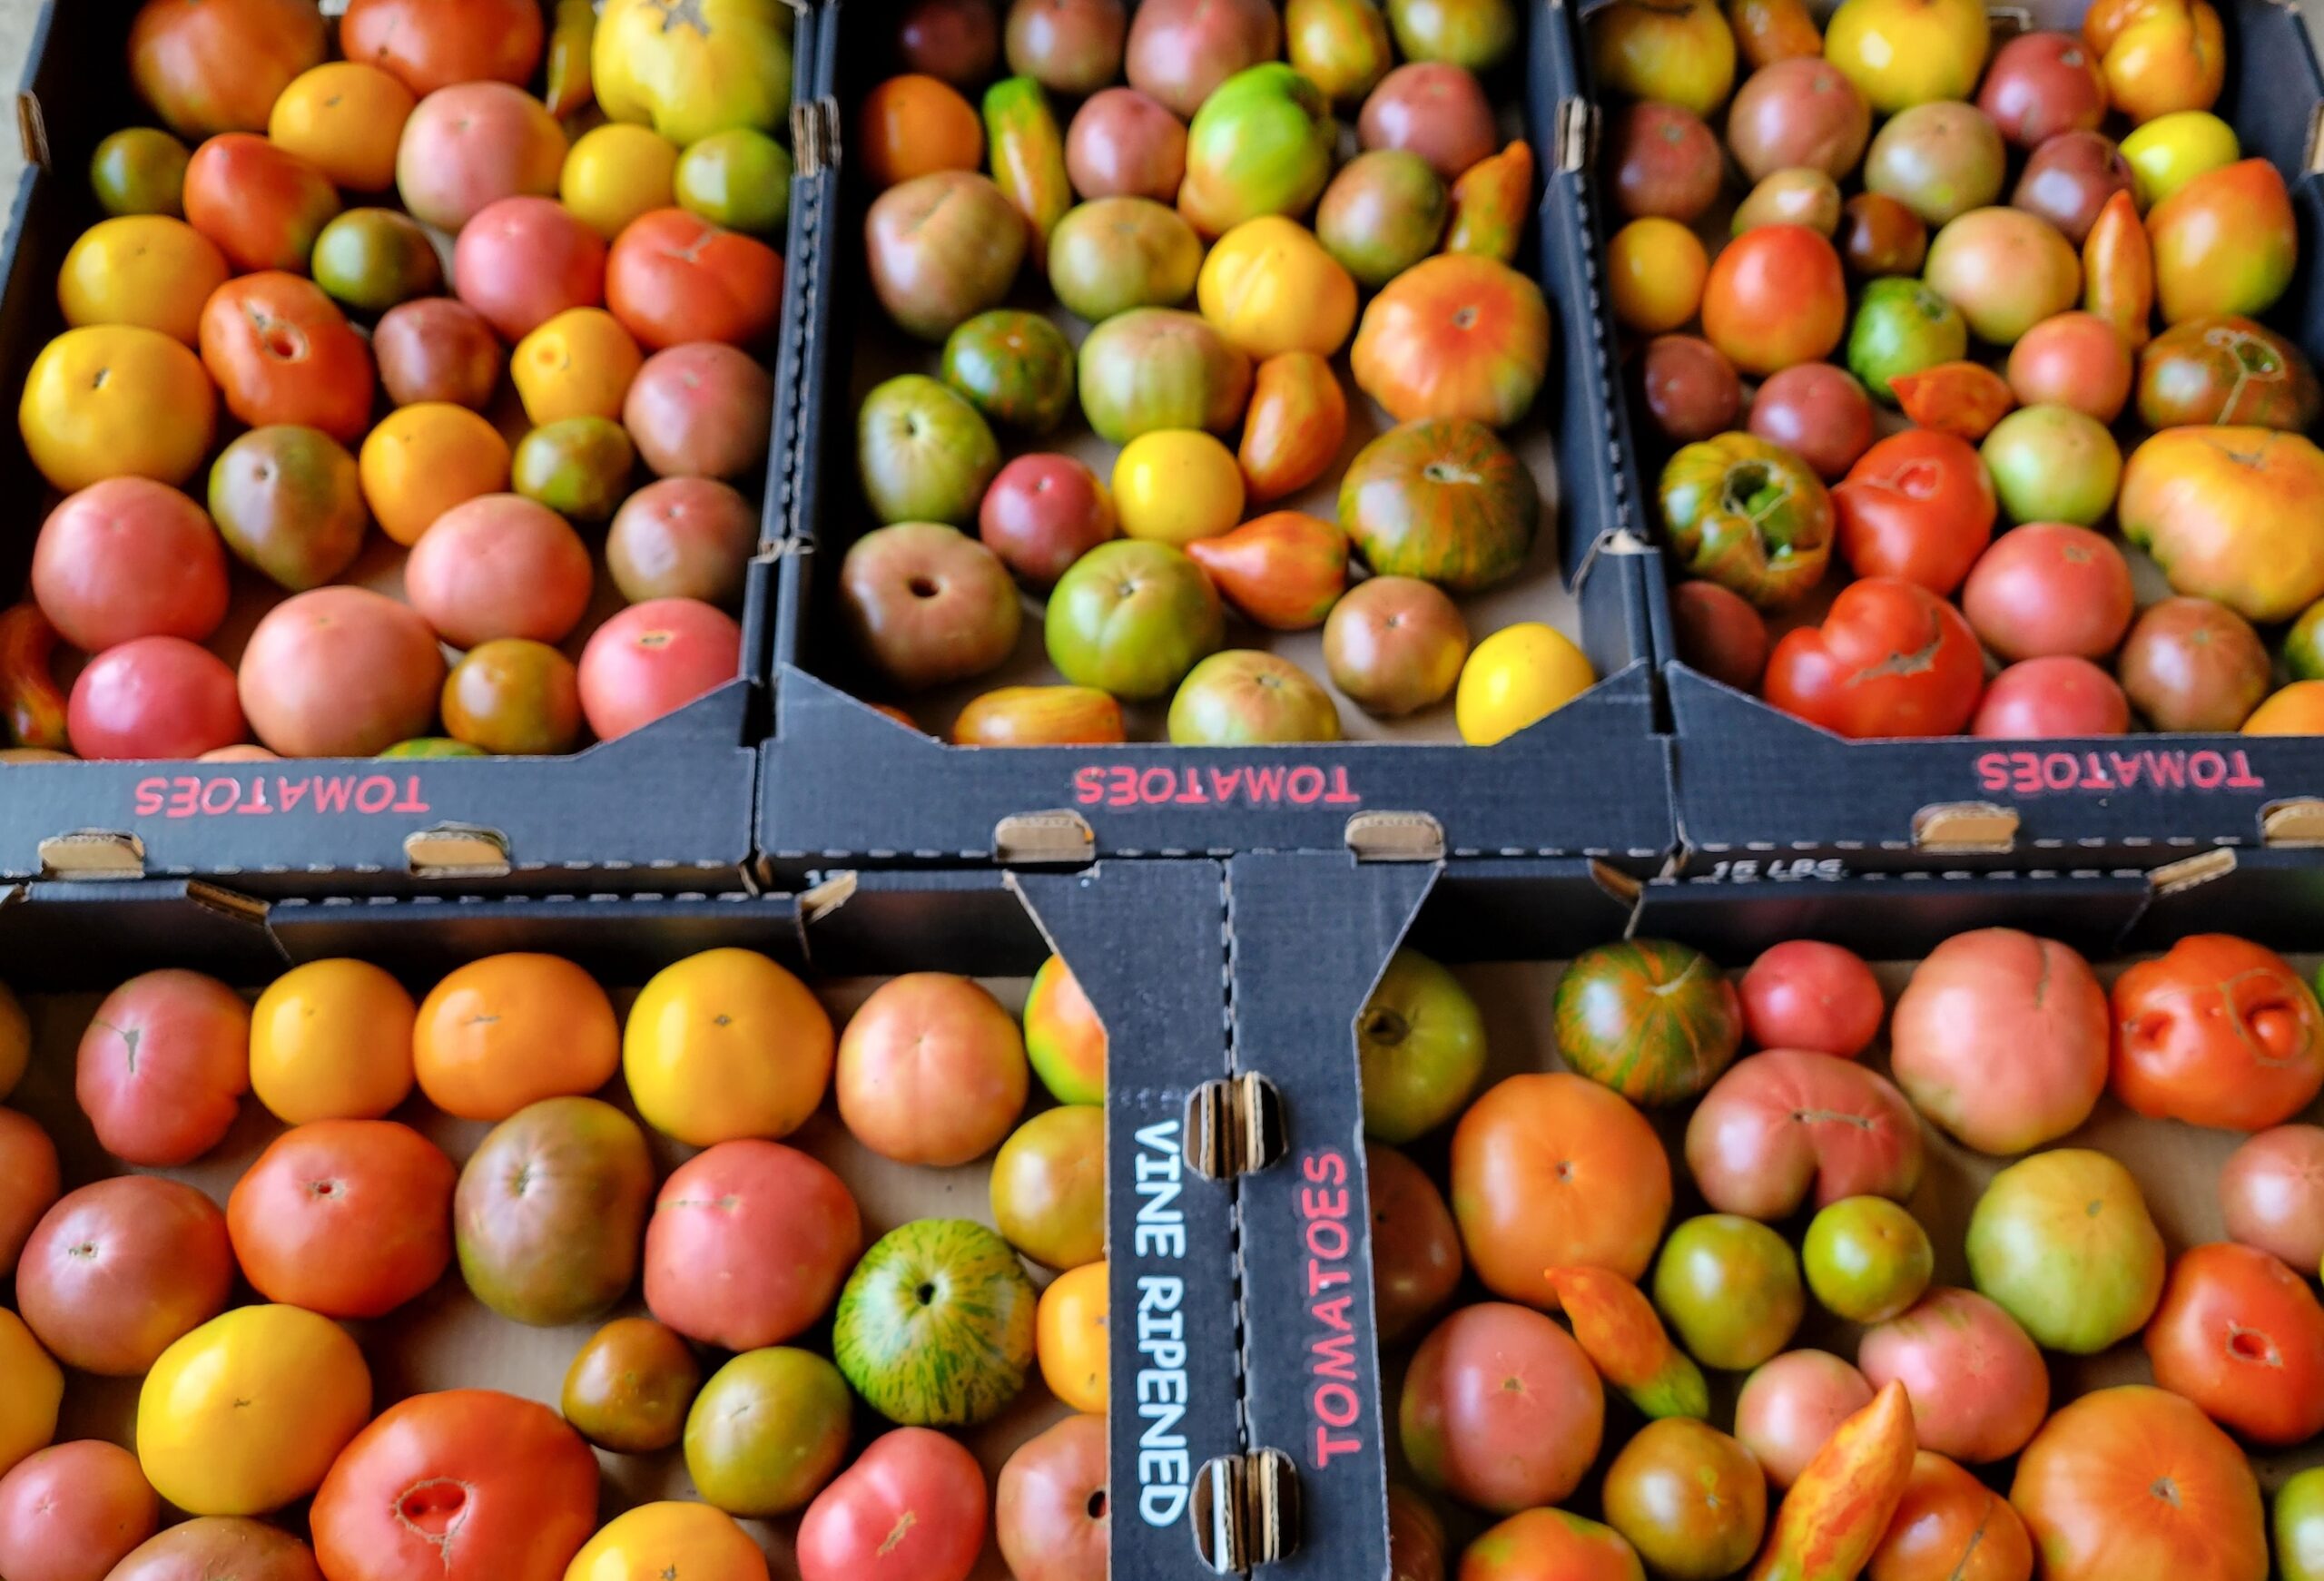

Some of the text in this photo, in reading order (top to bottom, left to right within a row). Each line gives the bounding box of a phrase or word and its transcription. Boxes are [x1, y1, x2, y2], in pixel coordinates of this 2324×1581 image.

[1074, 765, 1360, 807] TOMATOES
[1977, 750, 2263, 794] TOMATOES
[134, 775, 430, 818] TOMATOES
[1134, 1120, 1190, 1527] VINE RIPENED
[1301, 1152, 1362, 1468] TOMATOES
